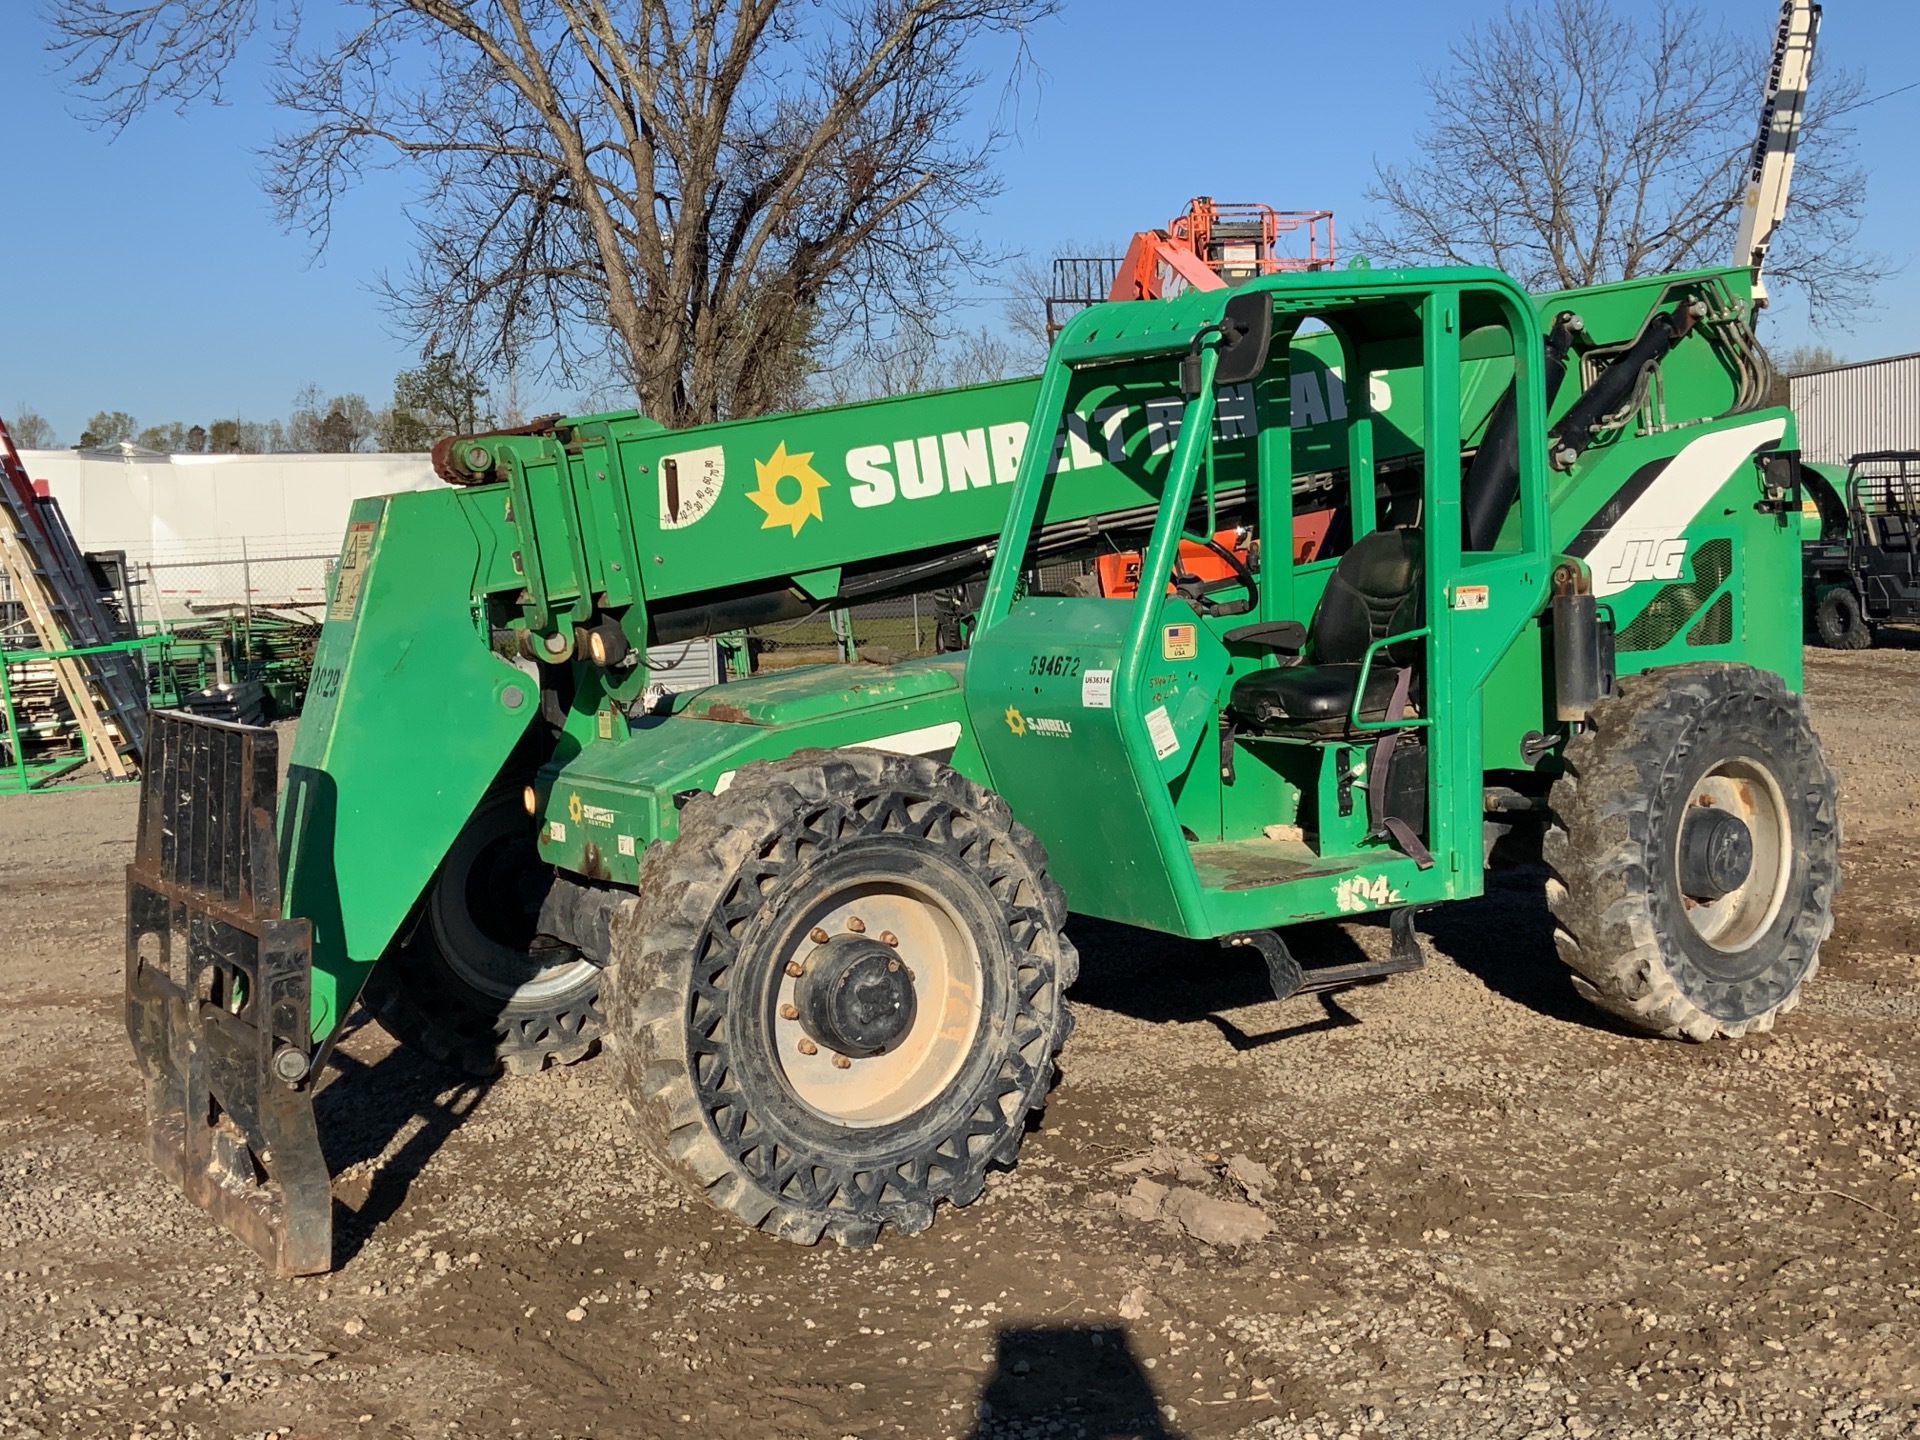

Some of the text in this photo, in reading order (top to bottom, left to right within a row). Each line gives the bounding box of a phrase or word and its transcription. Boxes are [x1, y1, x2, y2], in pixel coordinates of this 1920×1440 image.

[1752, 0, 1793, 183] SUNBELT RENTALS
[1606, 538, 1690, 584] JLG
[1029, 656, 1081, 677] 594672
